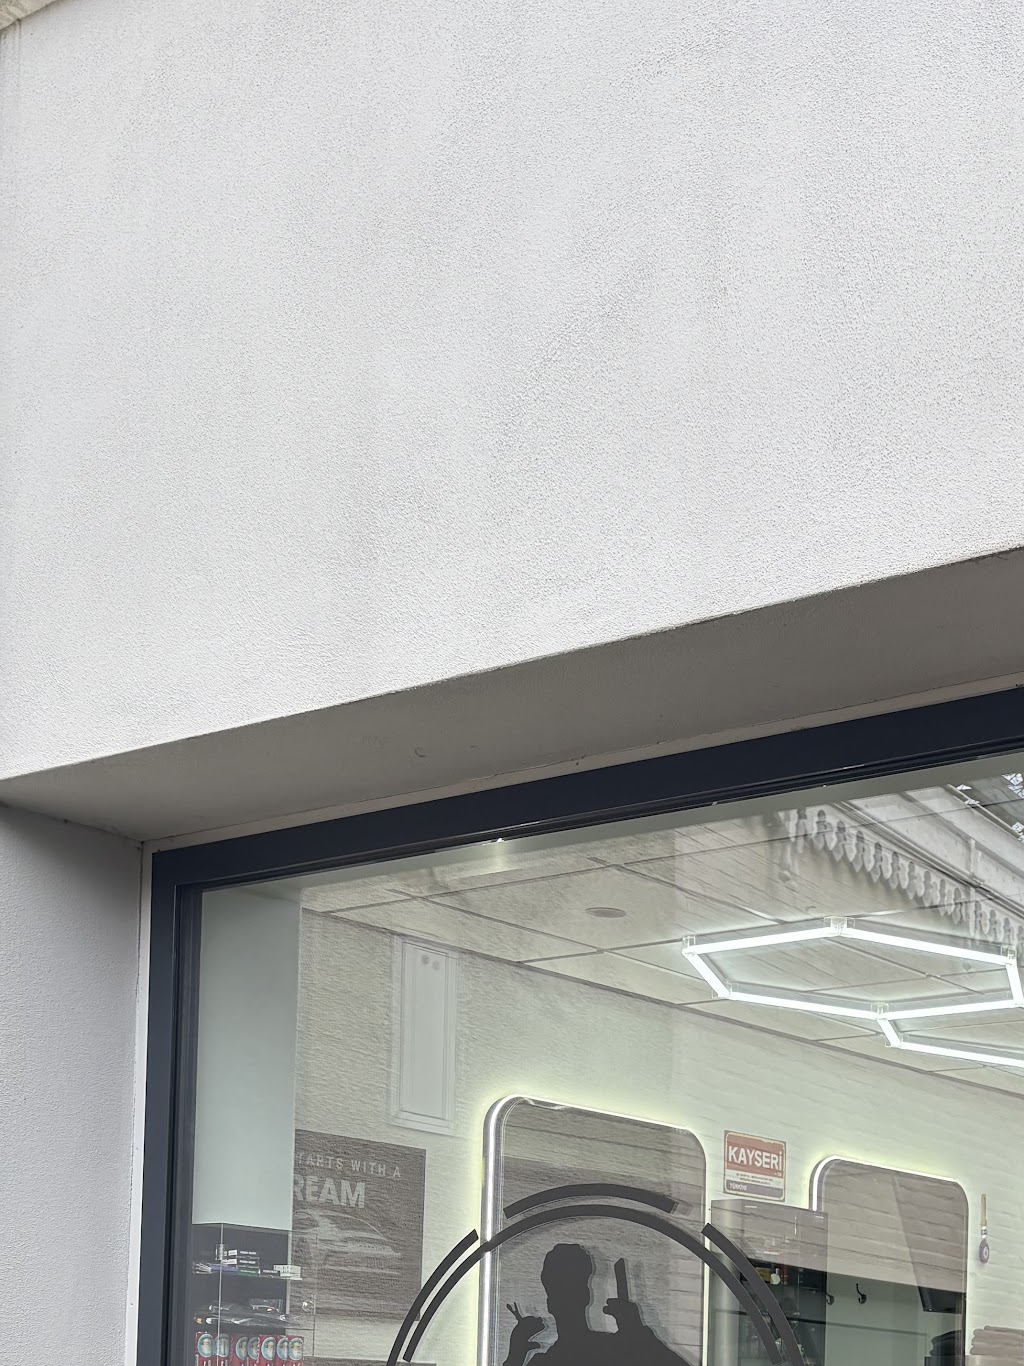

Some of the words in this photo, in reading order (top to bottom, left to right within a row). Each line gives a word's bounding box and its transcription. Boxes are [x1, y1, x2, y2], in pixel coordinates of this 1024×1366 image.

[297, 1152, 344, 1170] TARTS
[351, 1160, 386, 1177] WITH
[392, 1166, 401, 1178] A
[728, 1146, 782, 1171] KAYSERİ
[293, 1174, 366, 1209] REAM
